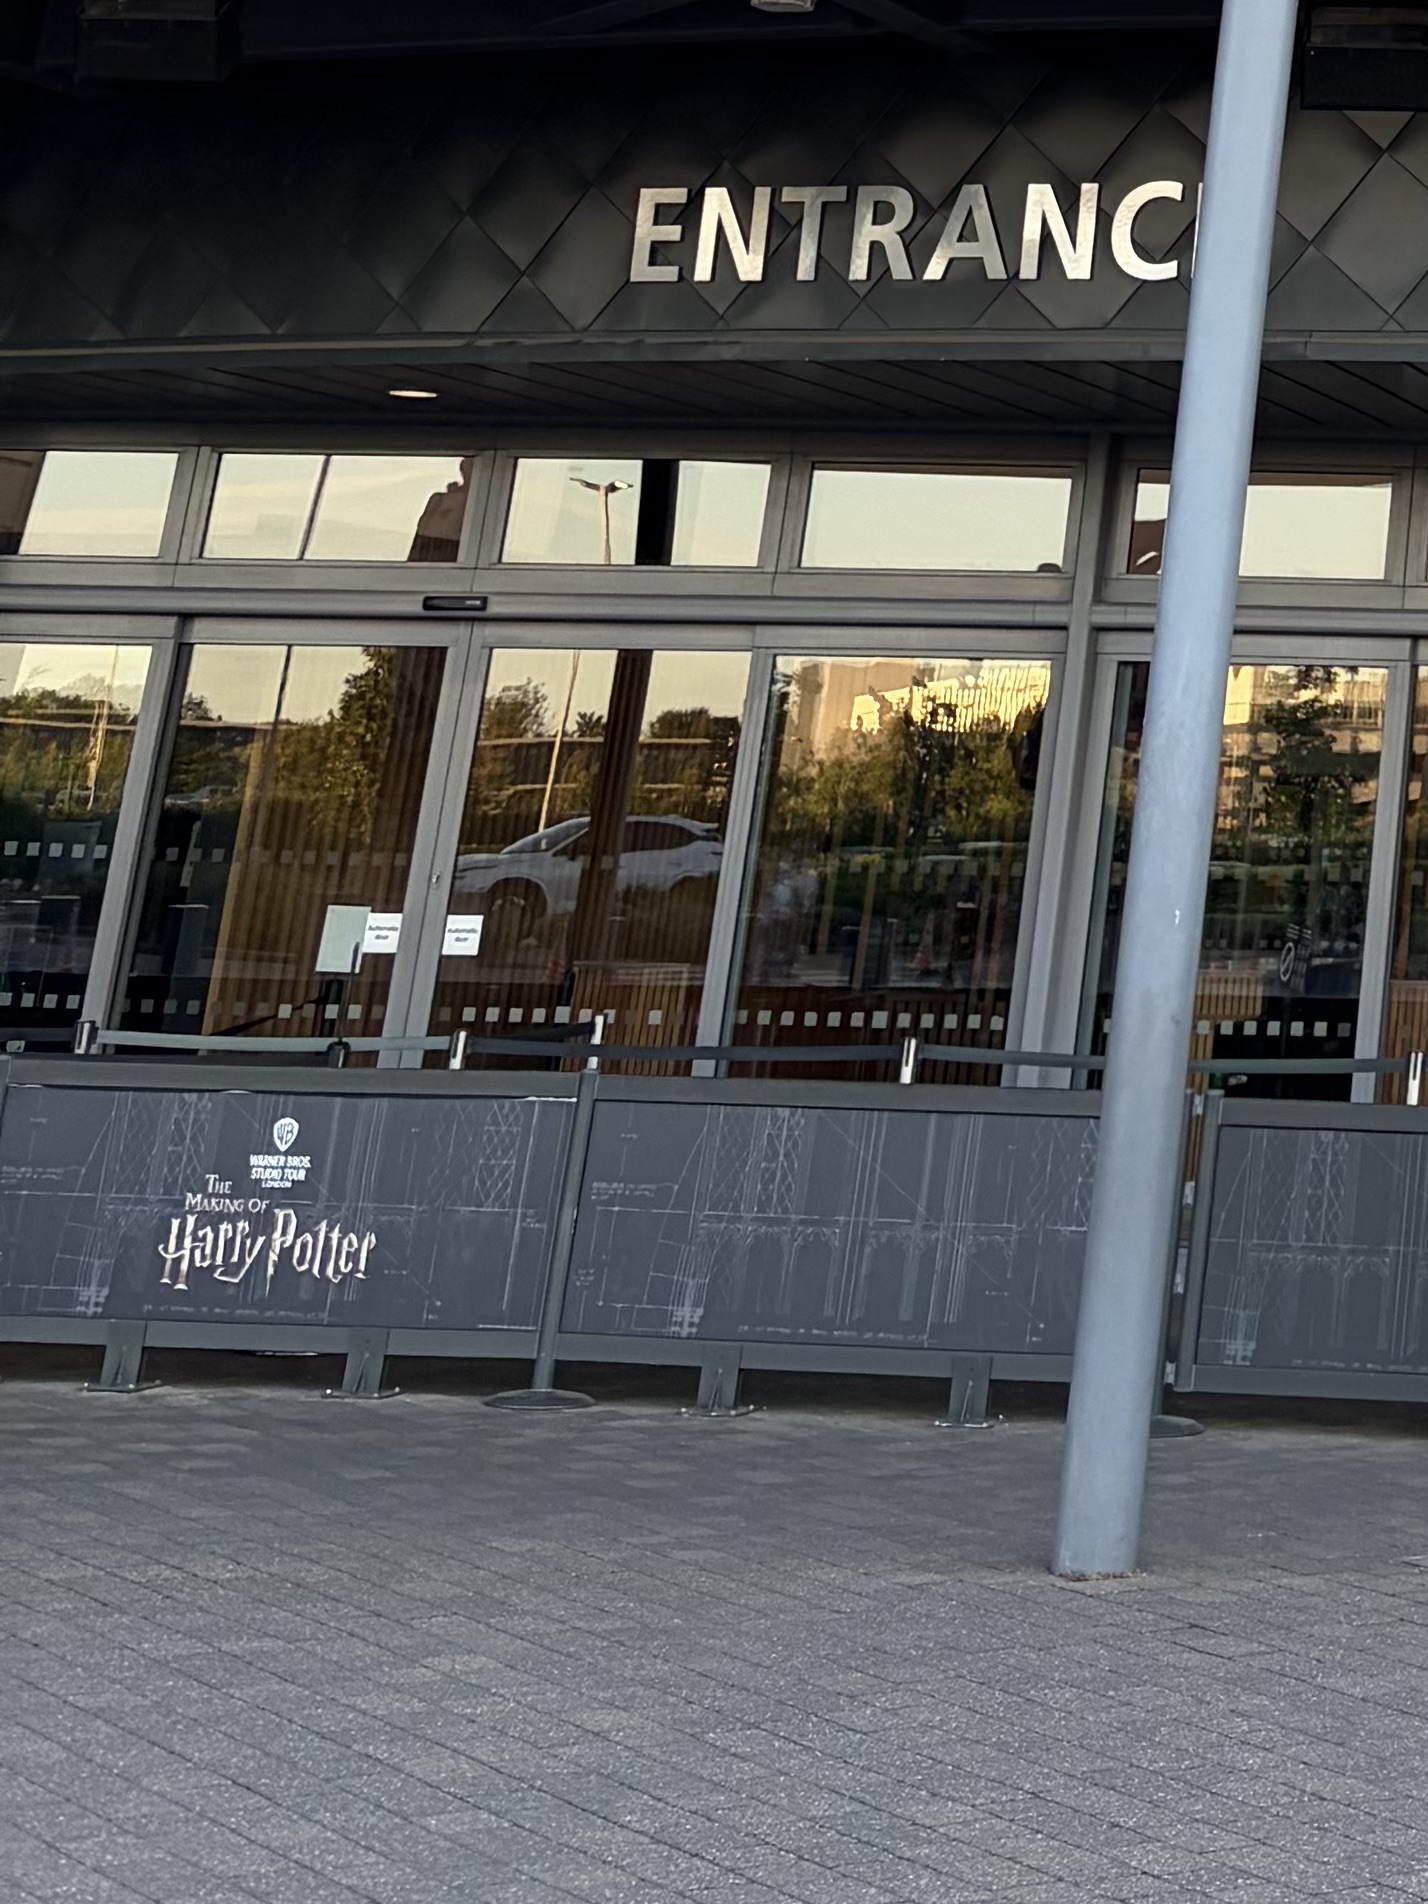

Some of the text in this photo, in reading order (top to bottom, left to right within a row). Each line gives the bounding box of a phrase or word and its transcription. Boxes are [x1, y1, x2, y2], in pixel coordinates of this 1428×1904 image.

[629, 180, 1205, 283] ENTRANC
[158, 1208, 377, 1297] Harry Potter
